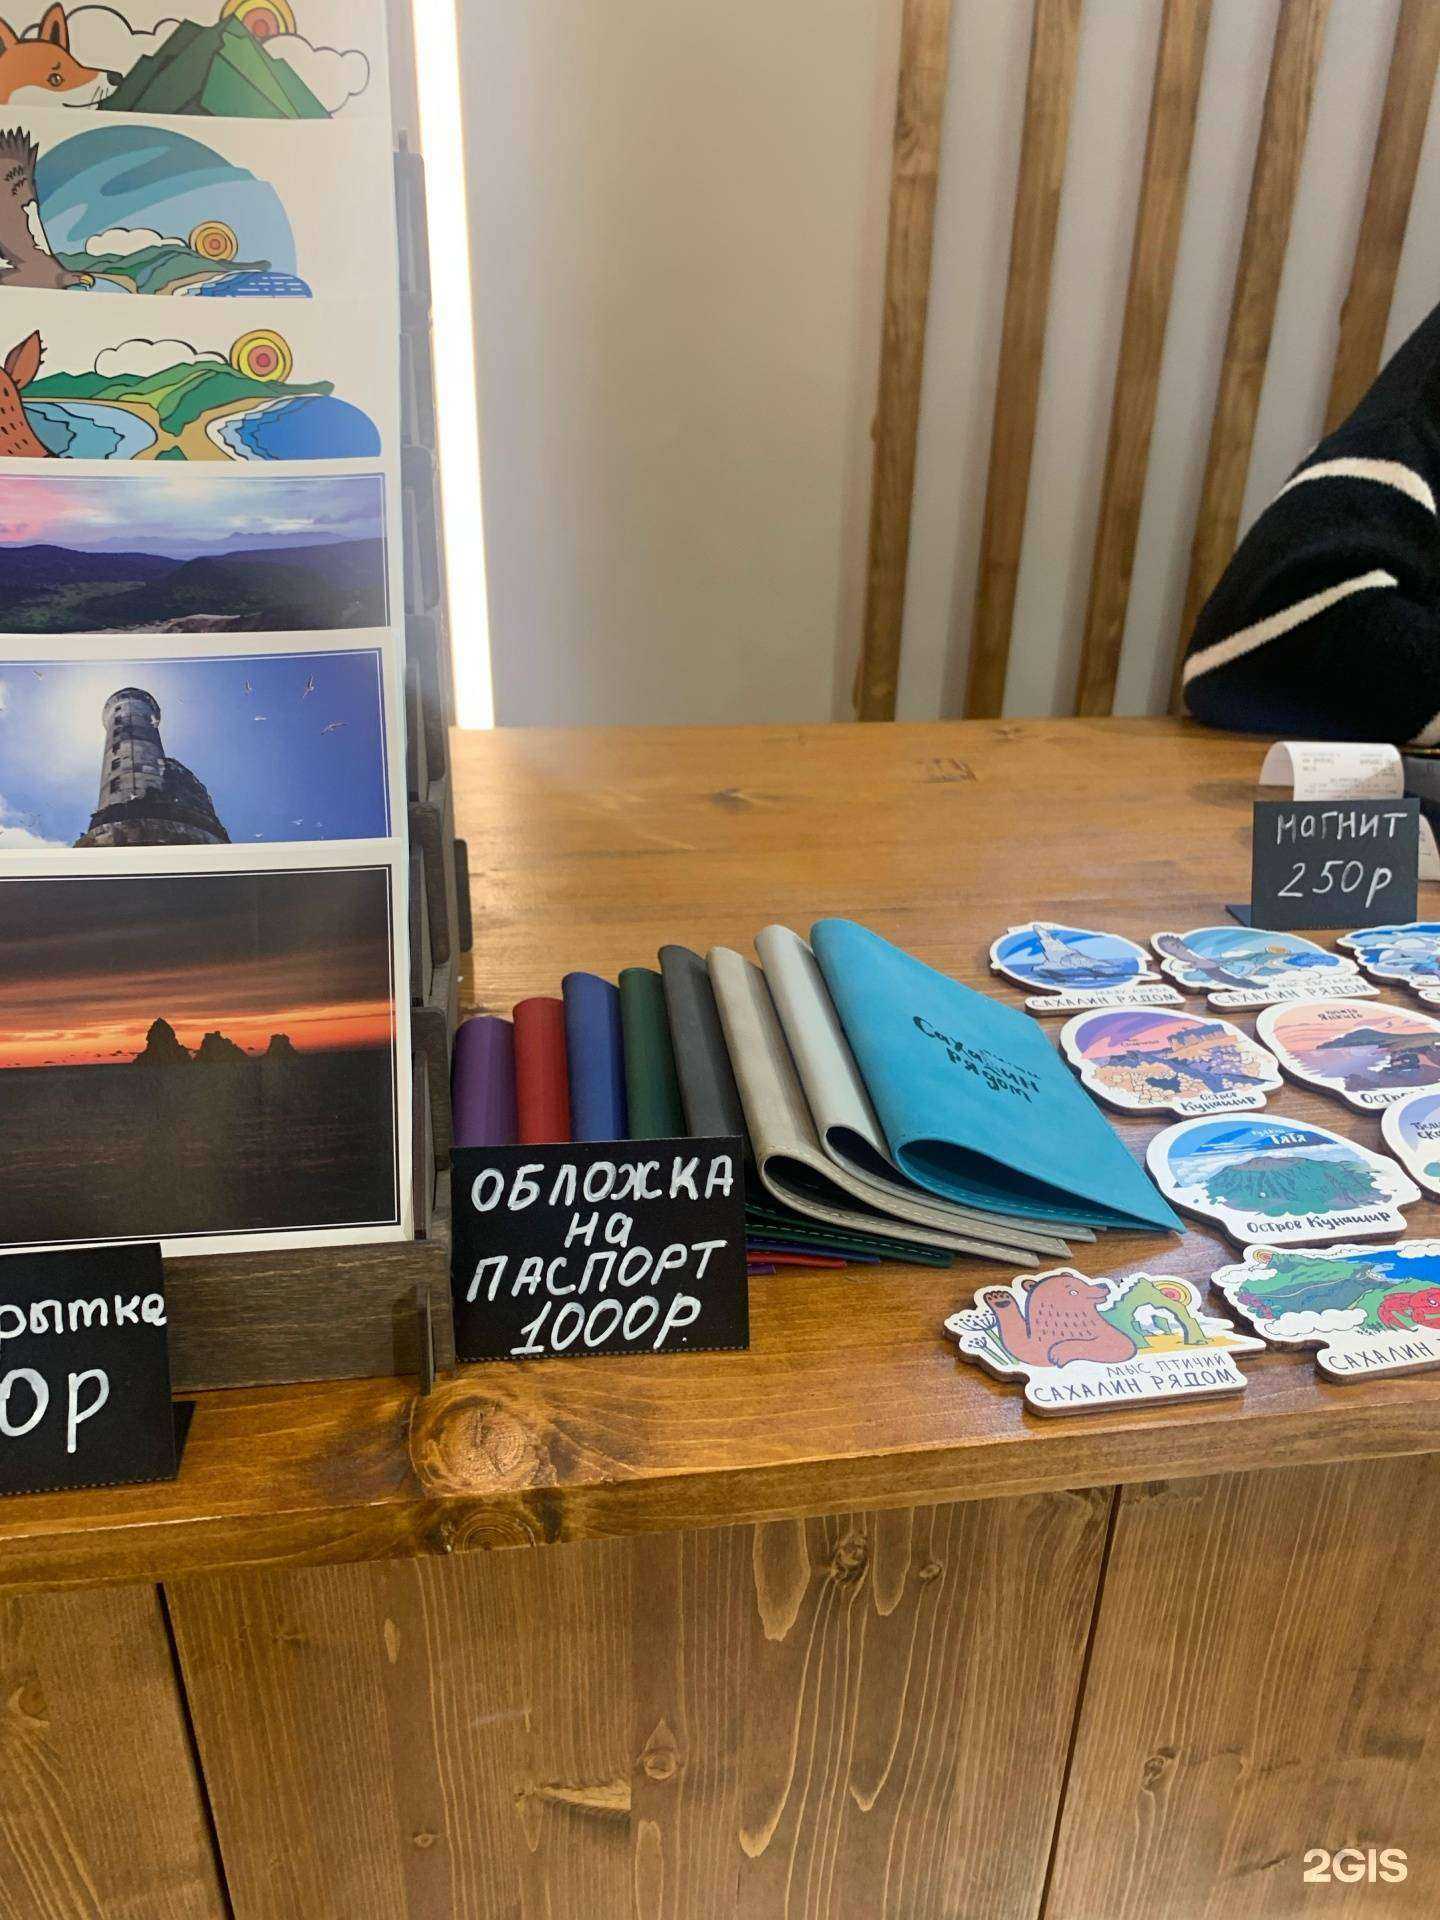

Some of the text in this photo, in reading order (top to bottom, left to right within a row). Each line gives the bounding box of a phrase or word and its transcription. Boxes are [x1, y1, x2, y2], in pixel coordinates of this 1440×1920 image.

[1277, 860, 1393, 908] 250р
[1031, 993, 1177, 1007] САХАЛИН РЯДОМ
[1215, 983, 1369, 1004] САХАЛИН РЯДОМ
[471, 1154, 734, 1212] ОБЛОЖКА
[564, 1211, 633, 1248] на
[1247, 1210, 1391, 1234] Остров Кунашир
[466, 1239, 728, 1303] ПАСПОРТ
[1106, 1353, 1227, 1378] МЫС ПТИЧИЙ
[1328, 1341, 1434, 1370] САХАЛИН
[1033, 1367, 1242, 1402] САХАЛИН РЯДОМ
